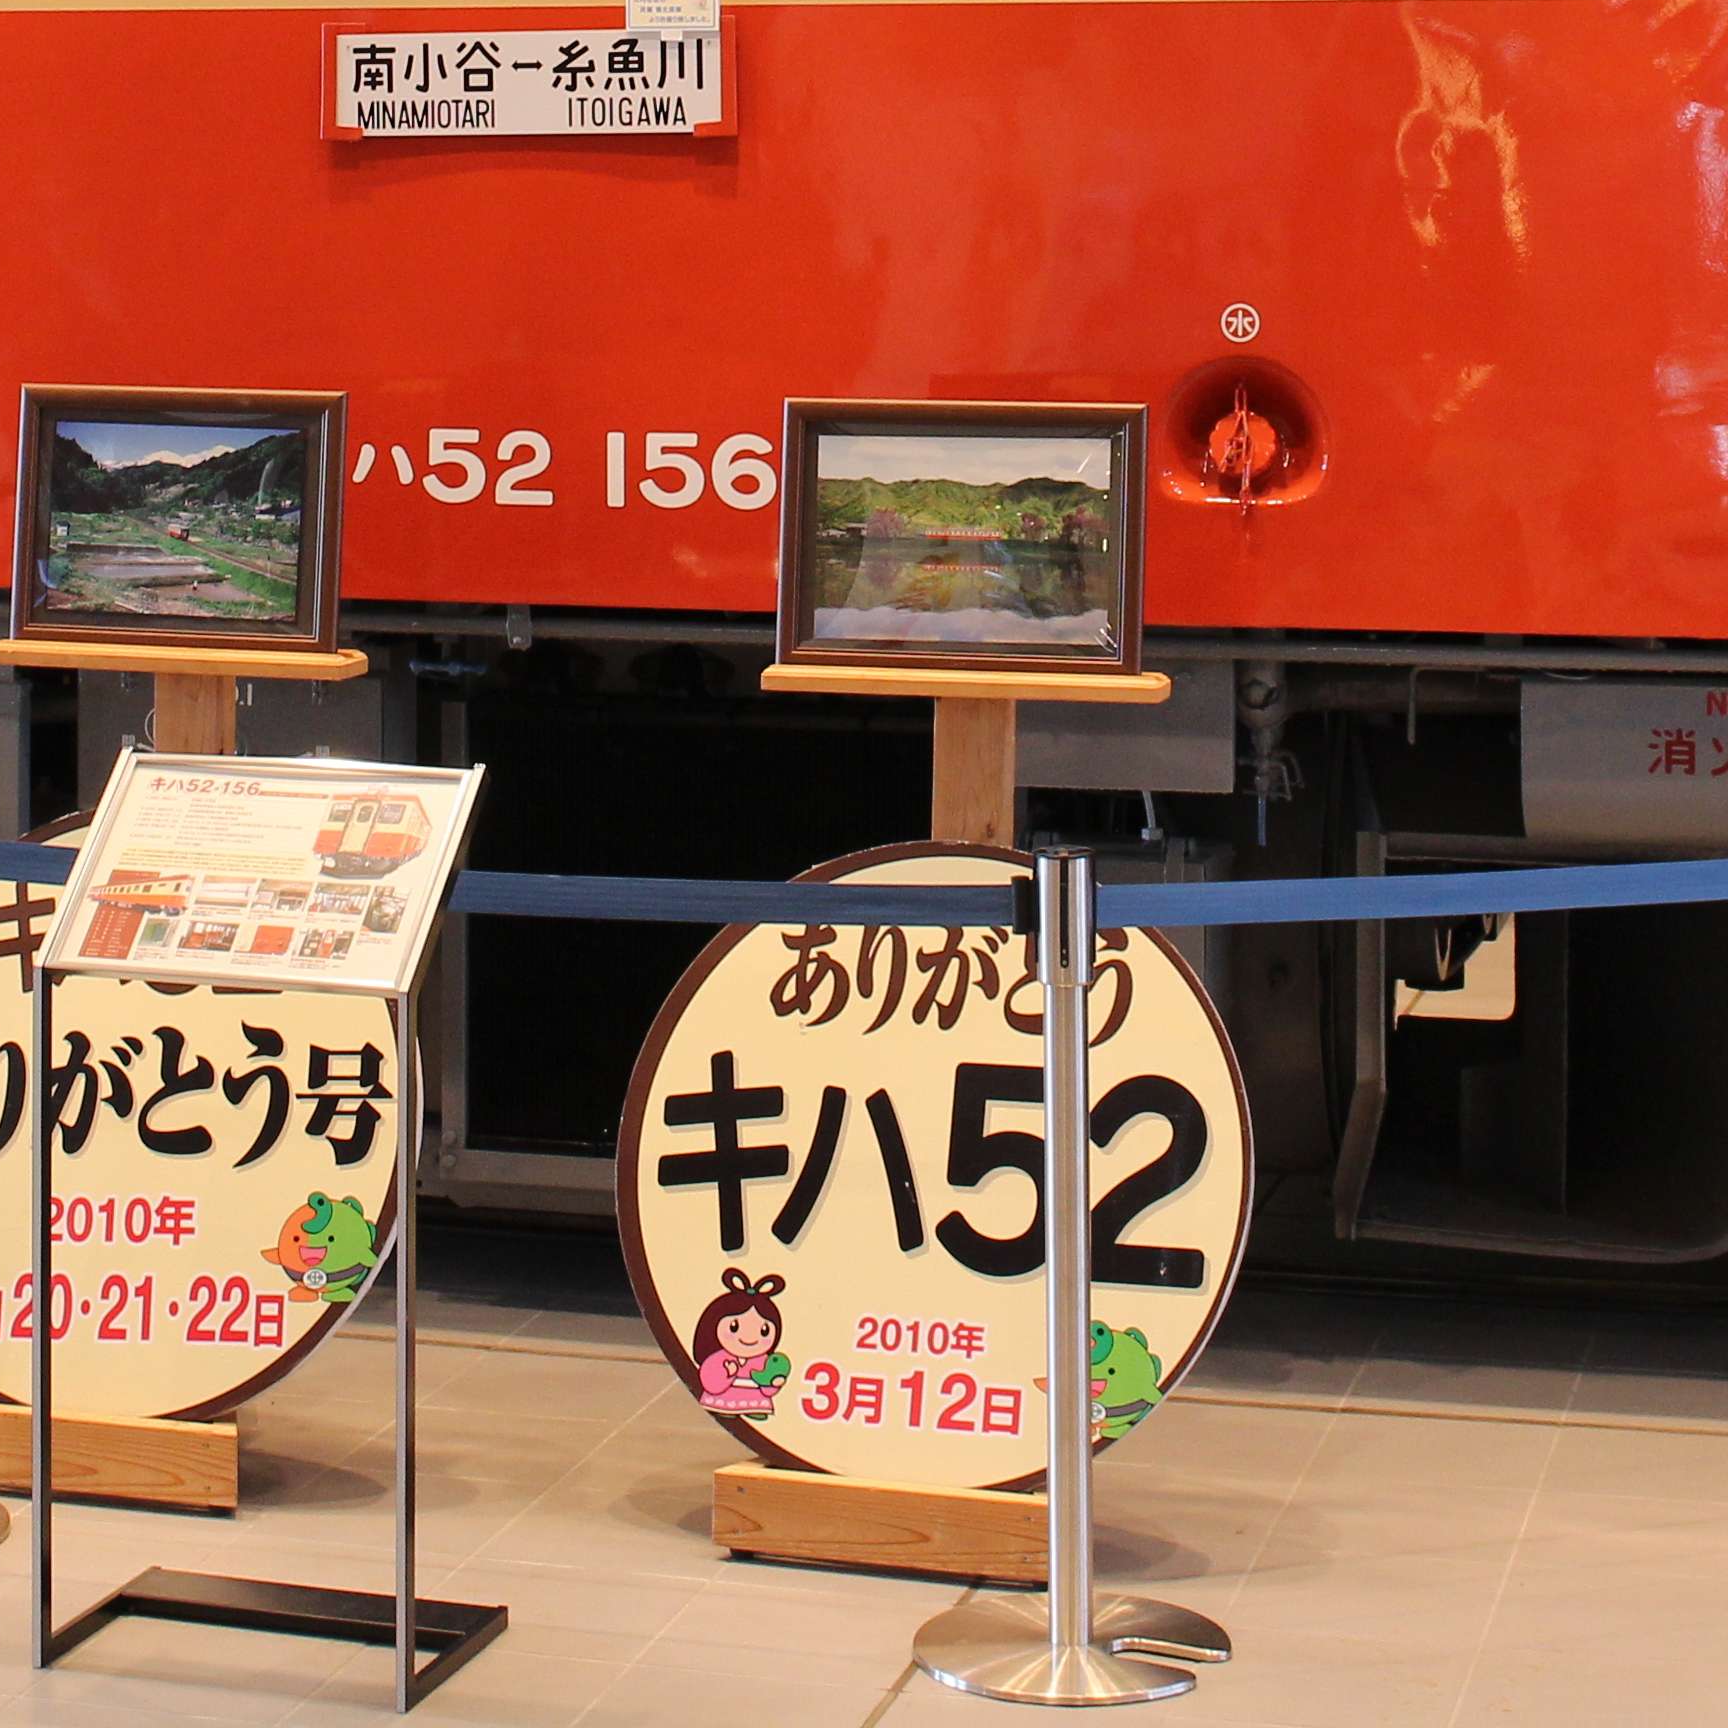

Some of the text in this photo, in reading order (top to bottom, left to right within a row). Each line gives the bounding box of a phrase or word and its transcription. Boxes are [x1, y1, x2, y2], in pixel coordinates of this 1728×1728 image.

[351, 37, 704, 94] 南小谷 糸魚川
[357, 95, 688, 130] MINAMIOTARI ITOIGAWA
[351, 427, 778, 511] ハ52 156
[657, 1050, 1209, 1289] キハ52
[855, 1317, 986, 1361] 2010年
[800, 1361, 1023, 1436] 3月12日
